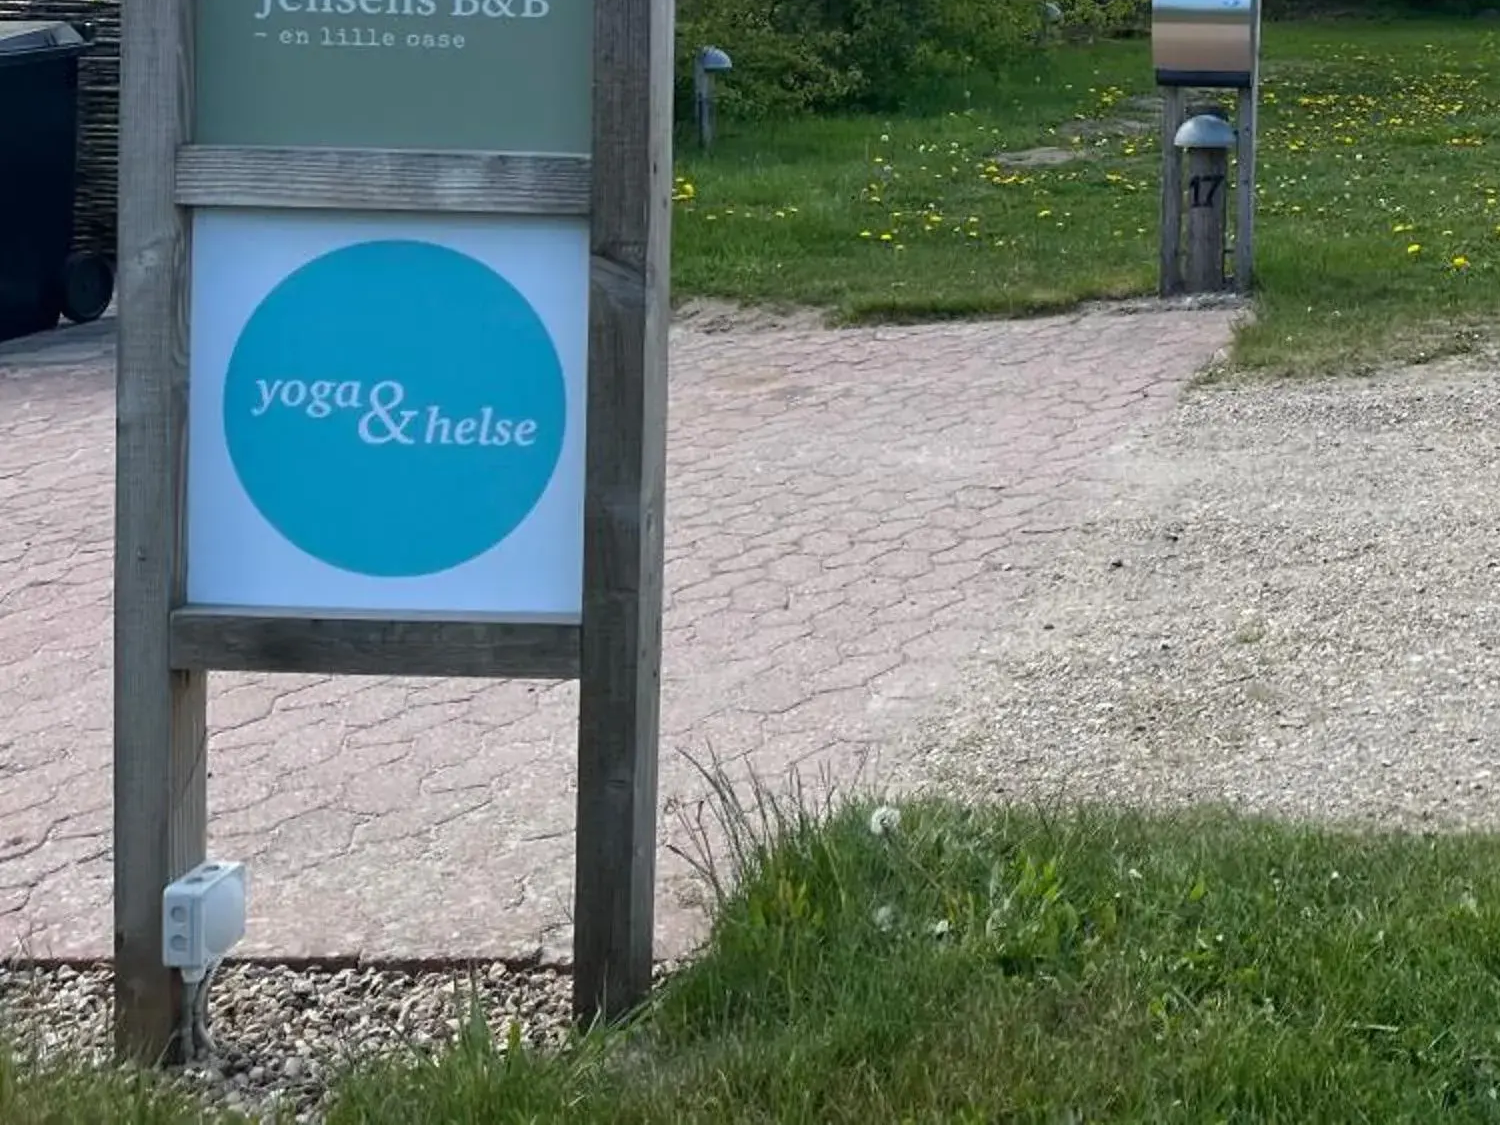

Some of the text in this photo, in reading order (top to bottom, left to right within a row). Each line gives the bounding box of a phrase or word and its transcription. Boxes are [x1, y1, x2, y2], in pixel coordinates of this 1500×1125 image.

[279, 28, 309, 45] en
[320, 27, 395, 47] lille
[406, 32, 465, 49] oase
[1189, 175, 1224, 208] 17
[251, 379, 537, 446] yoga & helse
